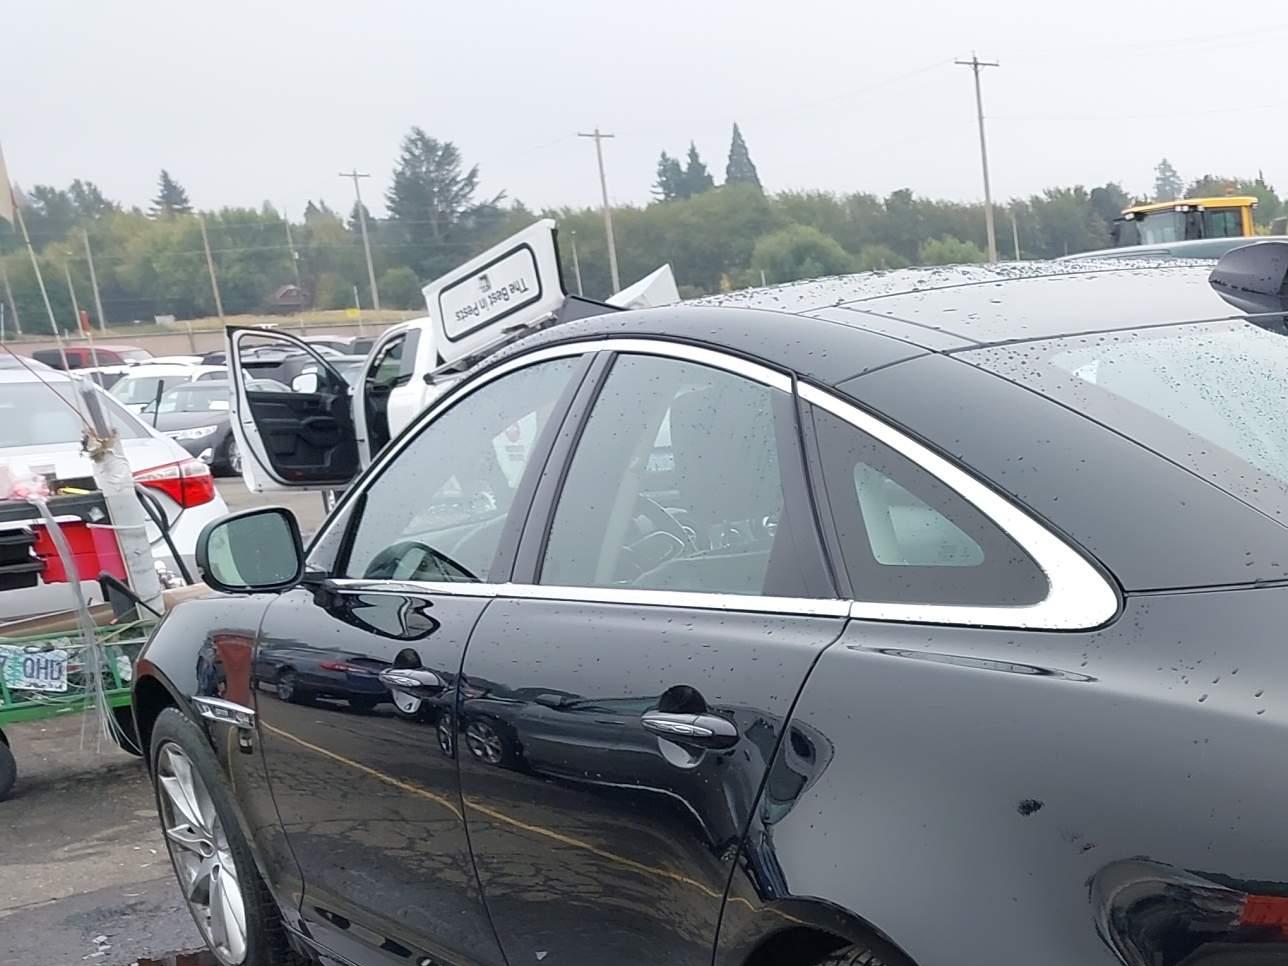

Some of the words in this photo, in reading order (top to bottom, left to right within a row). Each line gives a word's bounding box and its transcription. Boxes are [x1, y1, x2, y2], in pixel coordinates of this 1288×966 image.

[508, 278, 528, 293] The
[488, 287, 509, 305] Best
[479, 297, 490, 311] in
